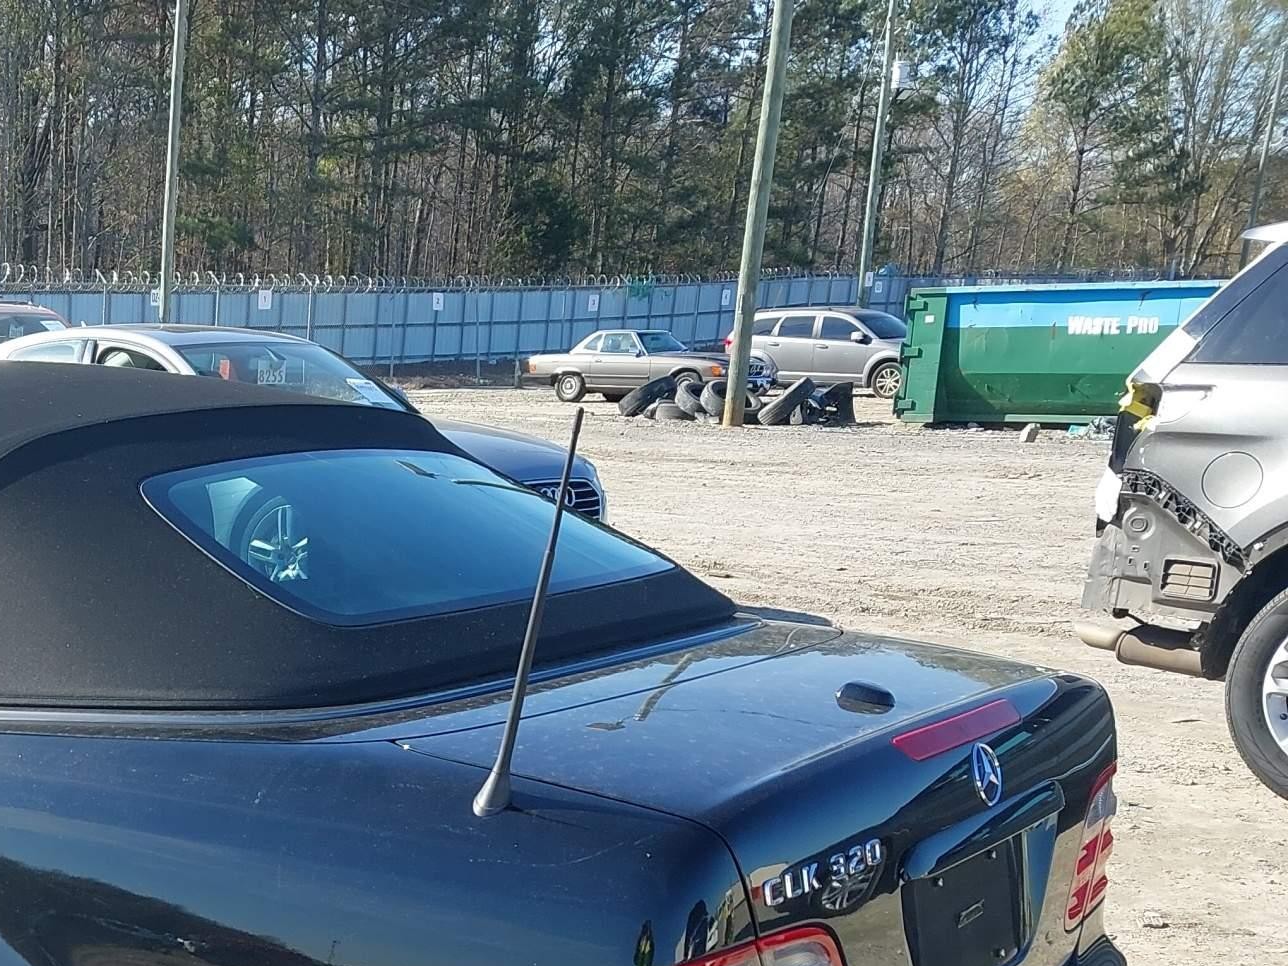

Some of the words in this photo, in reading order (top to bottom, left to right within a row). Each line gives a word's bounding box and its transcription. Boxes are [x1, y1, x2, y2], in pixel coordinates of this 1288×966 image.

[1068, 316, 1120, 335] WASTE
[763, 862, 822, 907] CLK
[829, 838, 881, 881] 320
